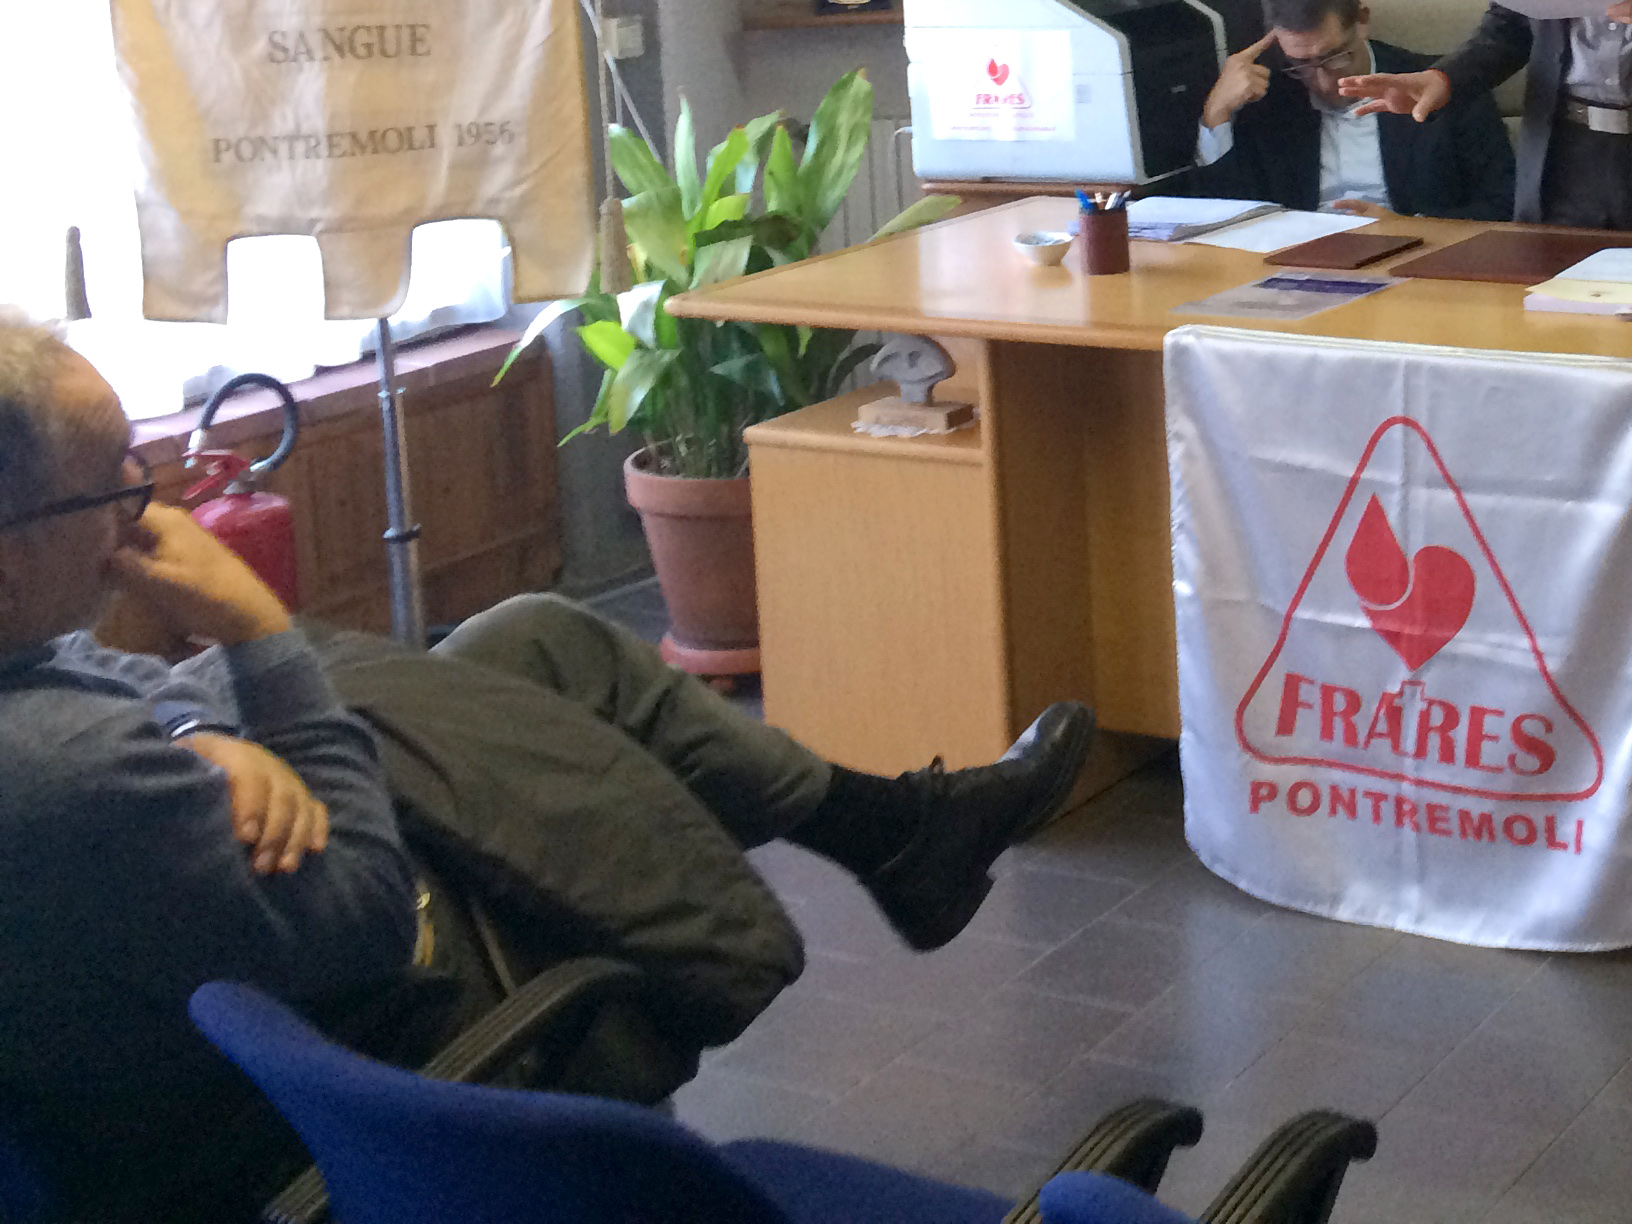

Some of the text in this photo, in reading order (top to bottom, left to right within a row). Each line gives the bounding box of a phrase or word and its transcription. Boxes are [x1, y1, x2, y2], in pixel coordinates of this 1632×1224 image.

[267, 23, 432, 64] SANGUE
[211, 120, 516, 164] PONTREMOLI 1956
[1249, 780, 1585, 855] PONTREMOLI
